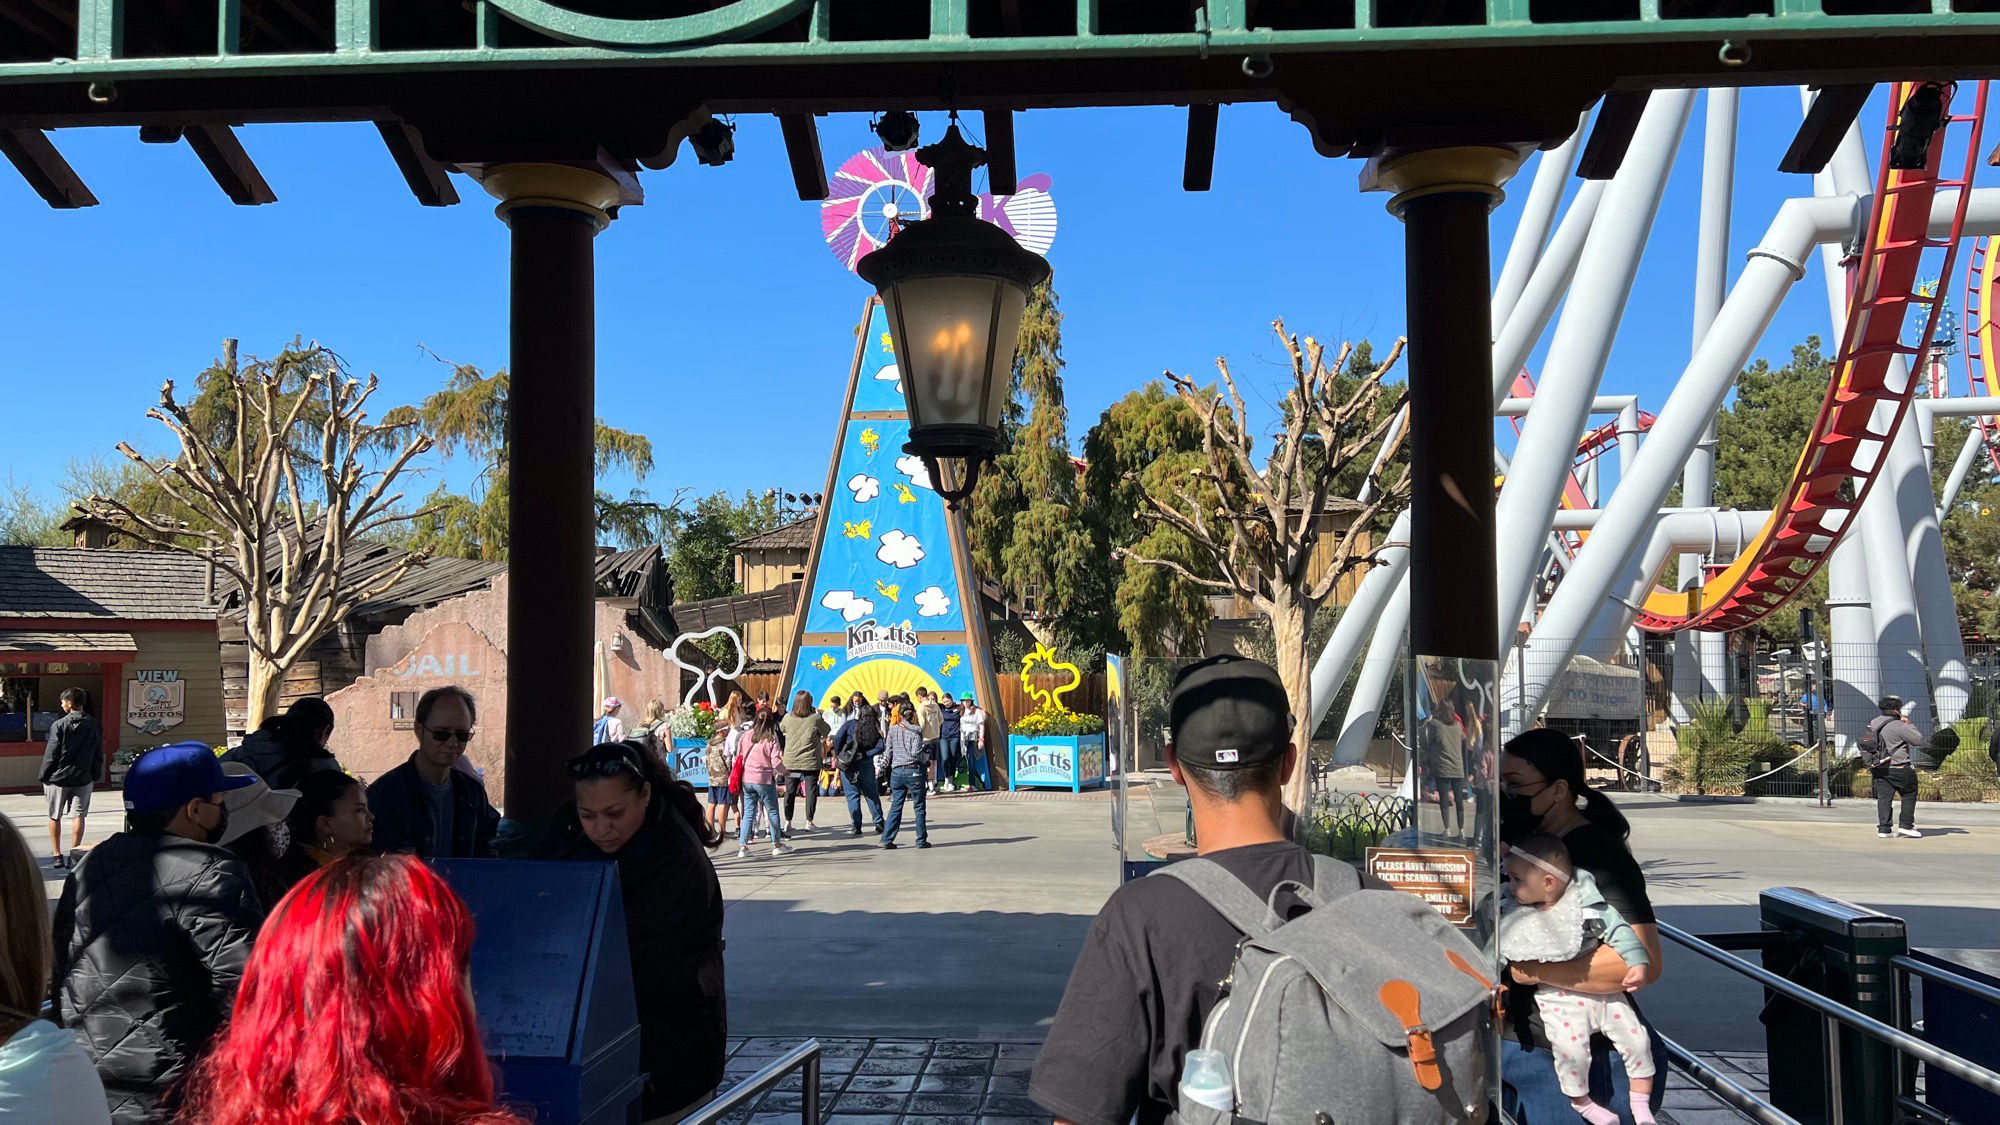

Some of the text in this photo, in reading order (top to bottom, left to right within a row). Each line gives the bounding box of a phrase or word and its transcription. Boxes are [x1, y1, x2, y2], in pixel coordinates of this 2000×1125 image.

[848, 642, 915, 657] PEANUTS CELEBRATION
[393, 654, 481, 677] JAIL
[137, 670, 178, 682] VIEW
[1376, 861, 1466, 873] PLEASE HAVE ADMISSION
[1377, 872, 1465, 884] TICKET SCANNED BELOW
[1424, 893, 1448, 903] SMILE
[1449, 894, 1463, 903] FOR
